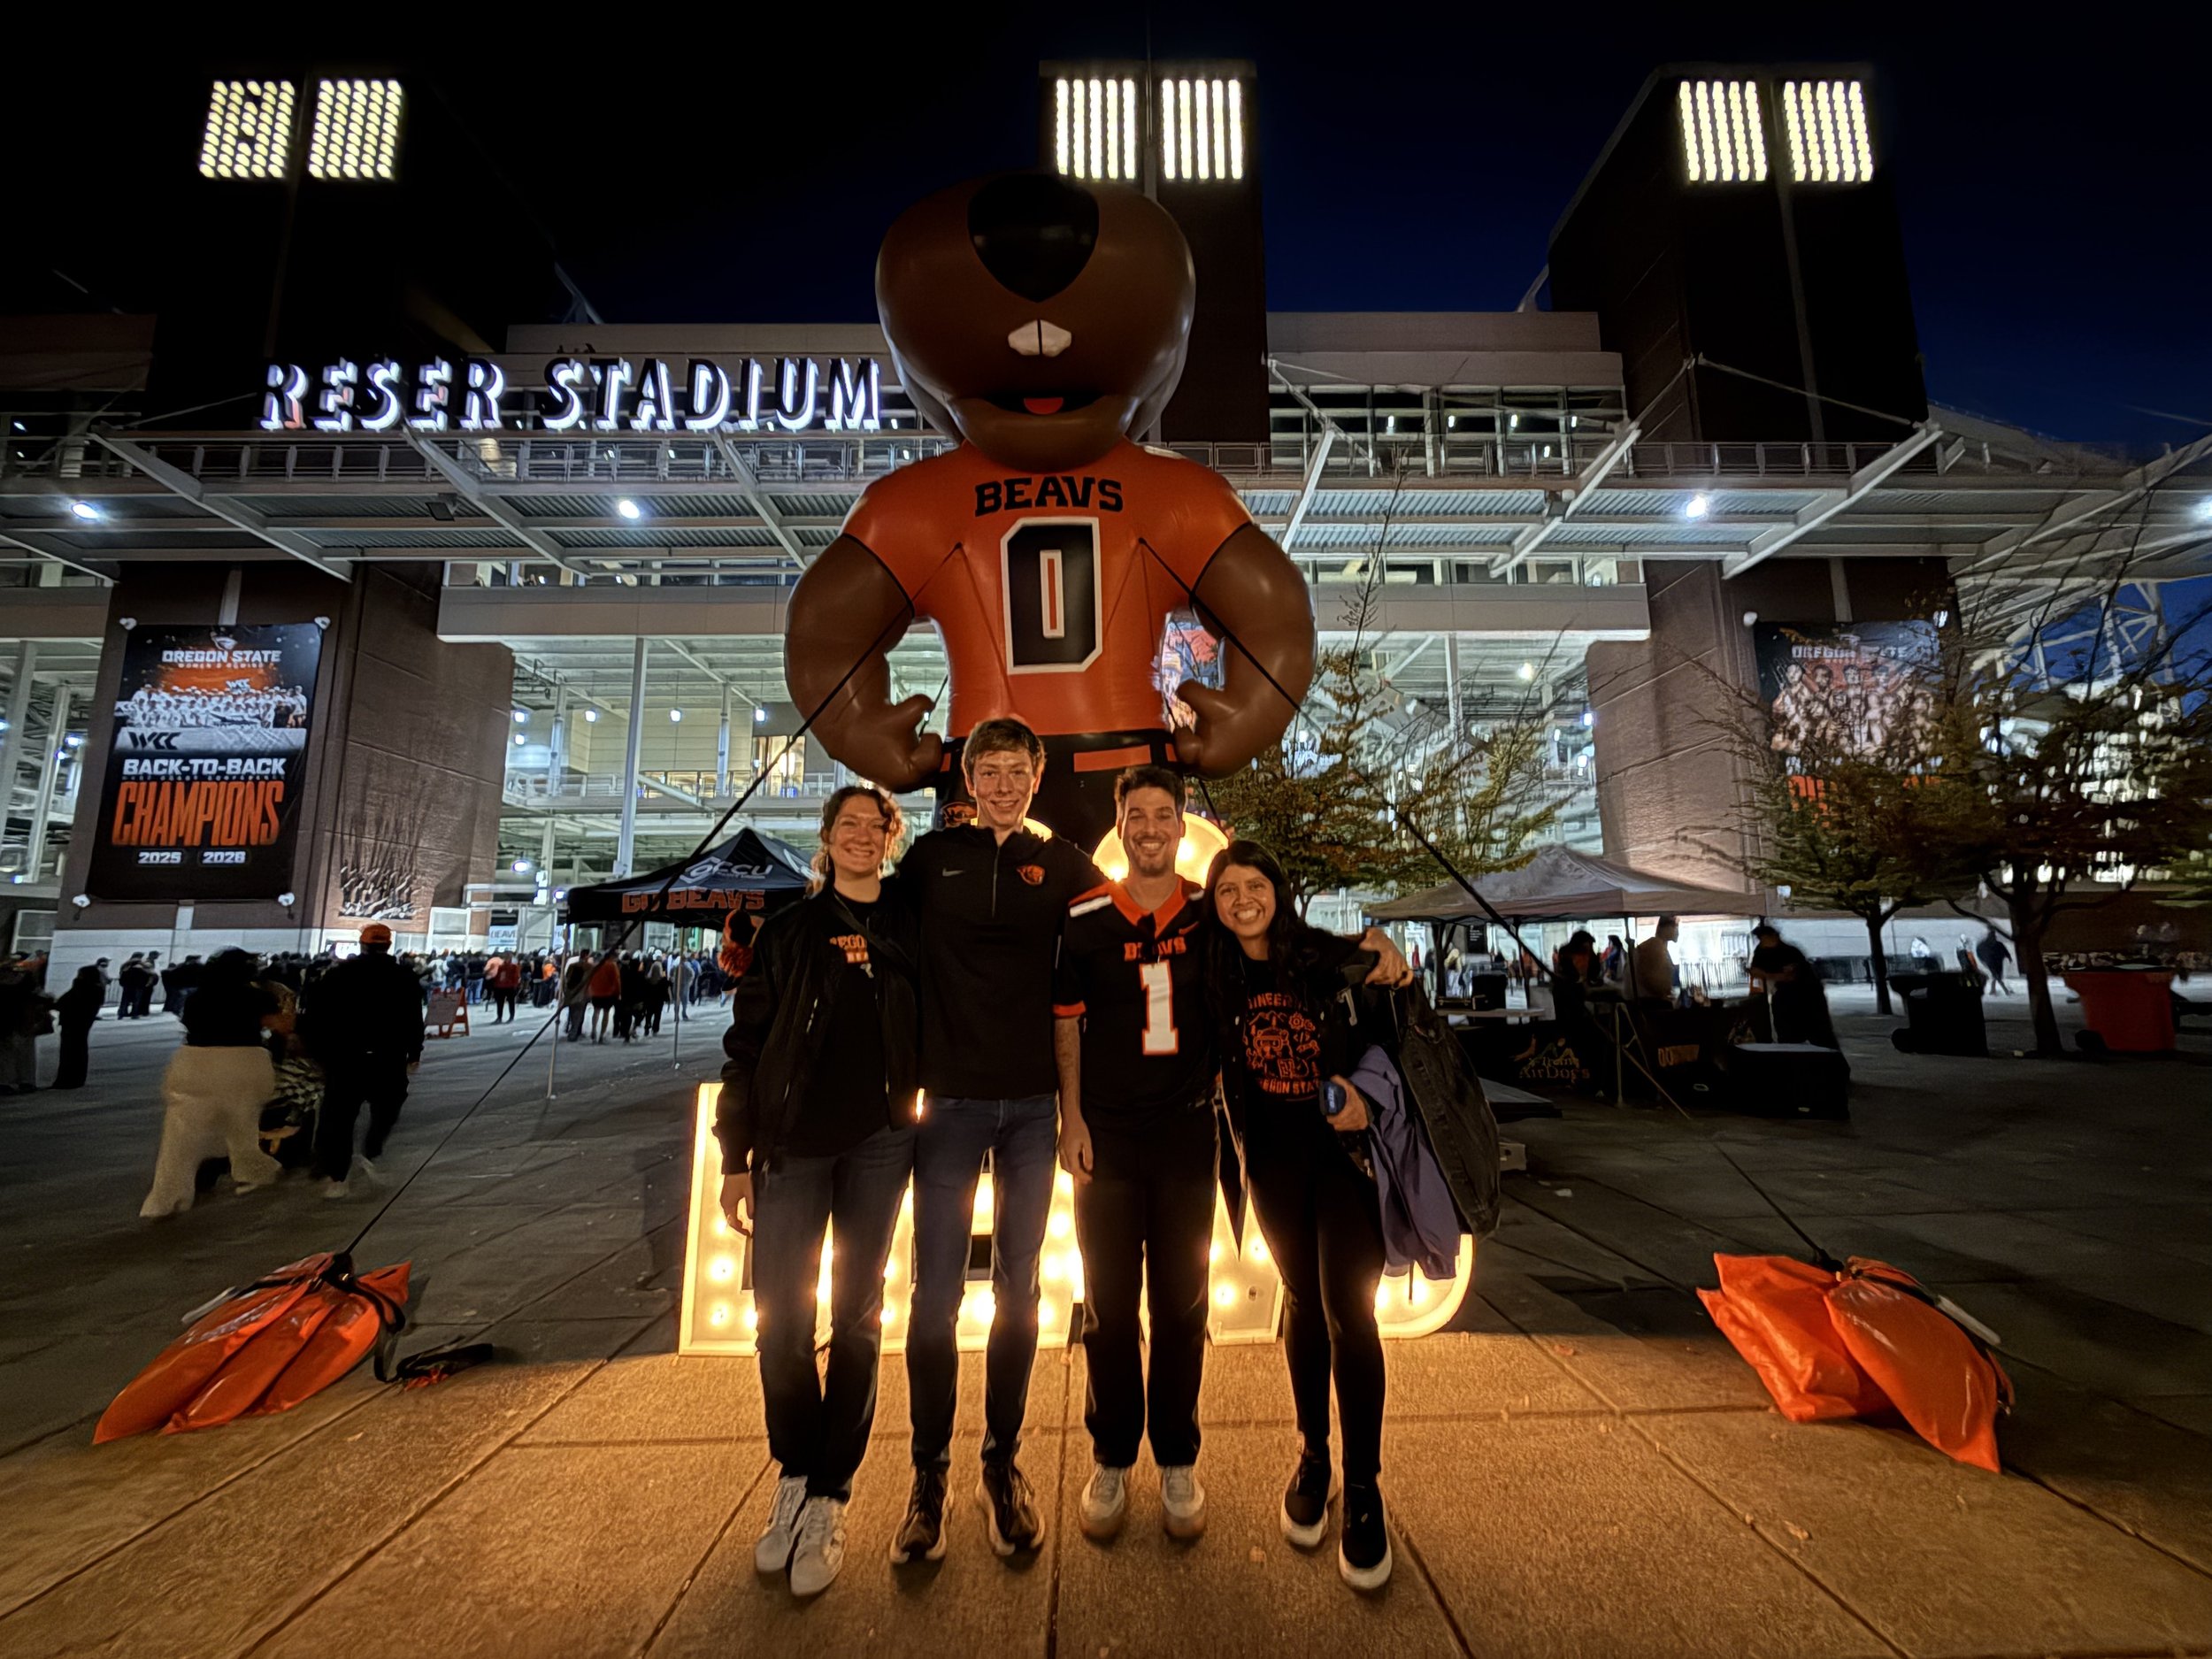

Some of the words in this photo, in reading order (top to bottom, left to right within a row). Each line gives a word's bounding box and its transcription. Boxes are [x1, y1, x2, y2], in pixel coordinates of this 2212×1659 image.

[261, 356, 508, 431] RESER
[540, 357, 882, 431] STADIUM
[974, 475, 1124, 517] BEAVS
[161, 649, 228, 663] OREGON
[232, 649, 282, 663] STATE
[127, 731, 181, 750] WCC
[122, 758, 288, 775] BACK-TO-BACK
[111, 780, 285, 846] CHAMPIONS
[137, 851, 182, 864] 2025
[666, 886, 765, 910] BEAVS
[1140, 959, 1179, 1056] 1
